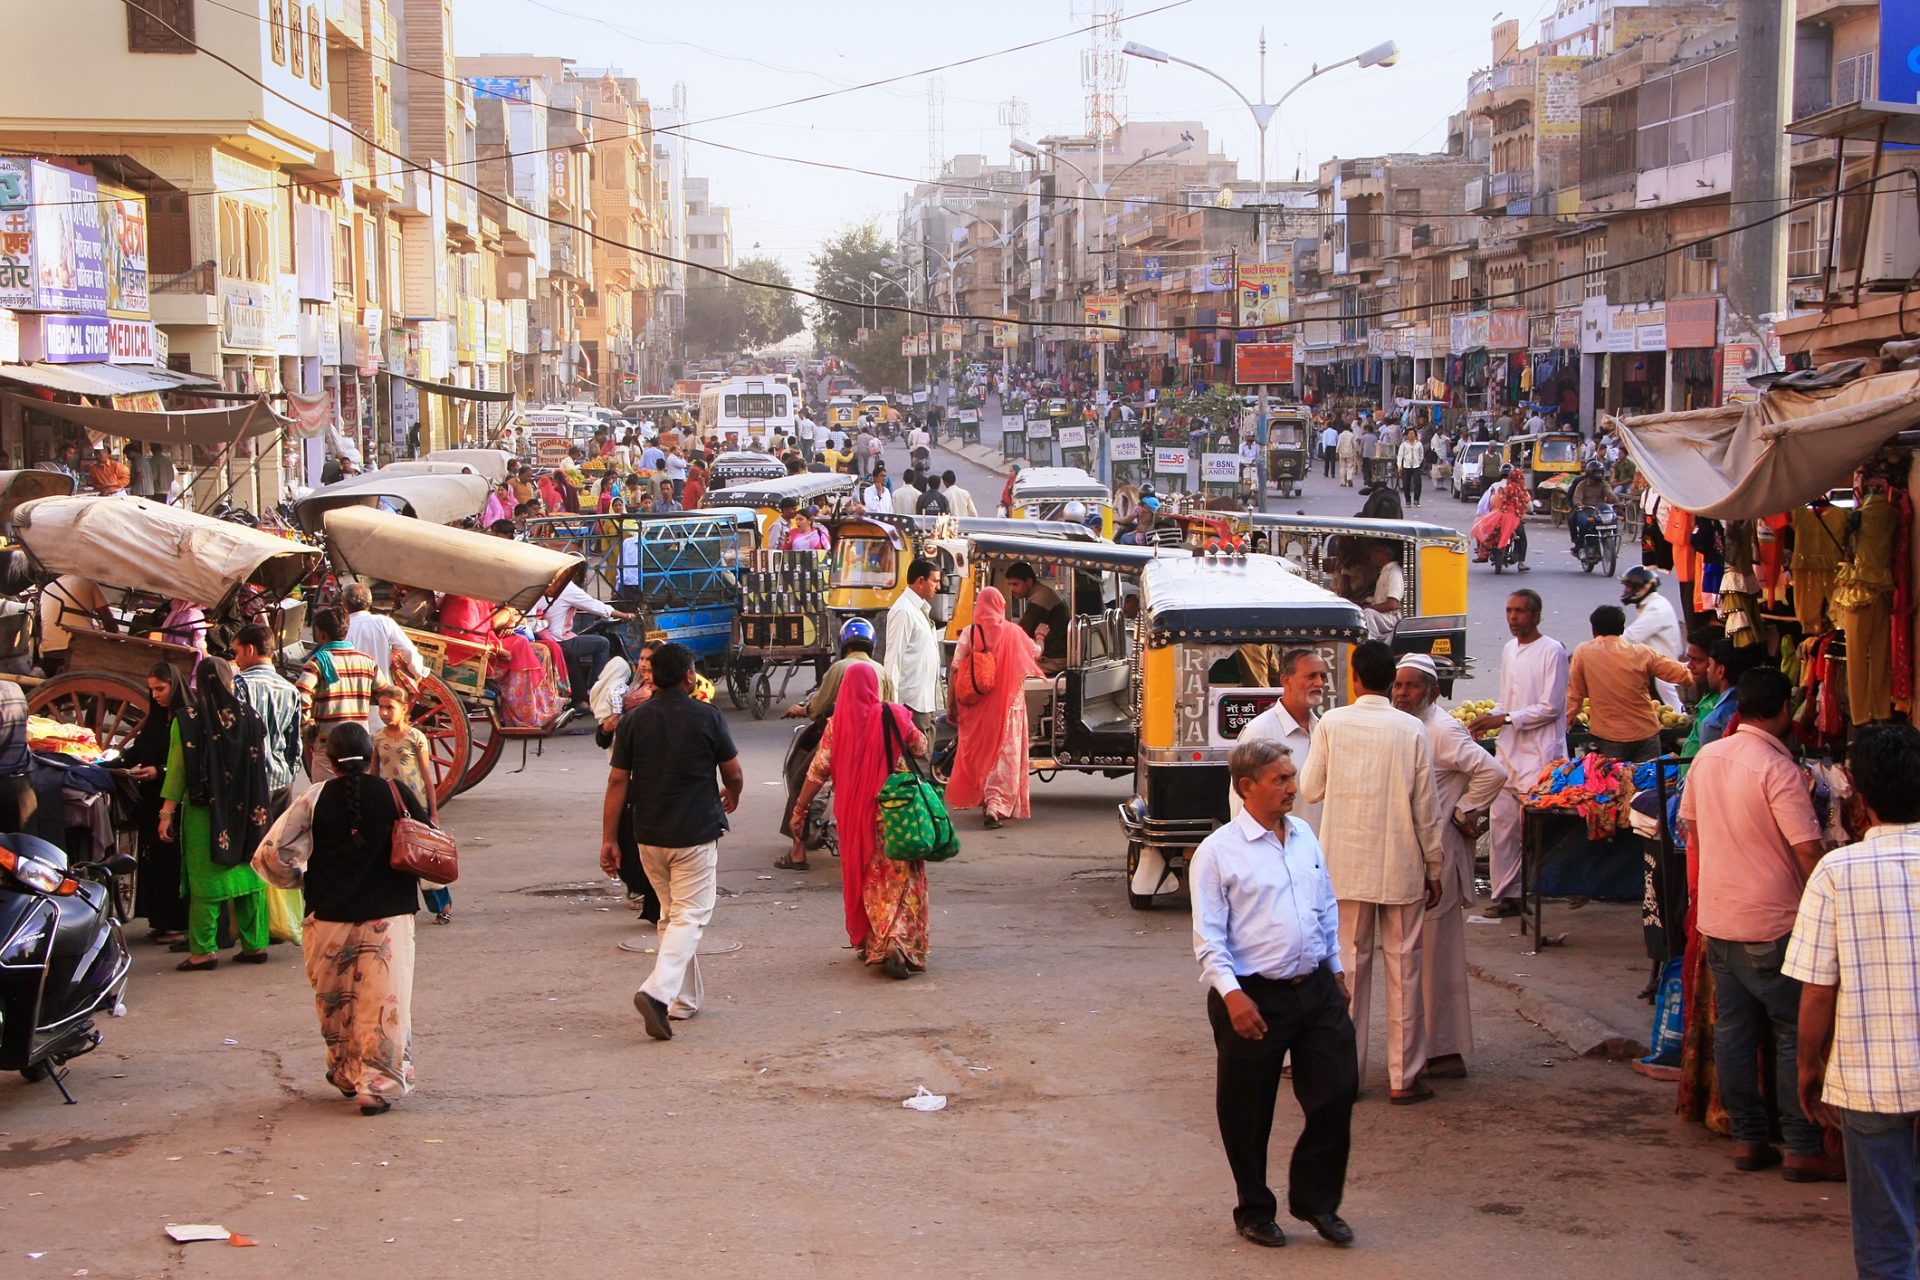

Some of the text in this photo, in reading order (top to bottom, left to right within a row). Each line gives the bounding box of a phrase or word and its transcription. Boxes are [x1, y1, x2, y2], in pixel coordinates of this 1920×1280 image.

[48, 324, 109, 354] MEDICAL STORE
[109, 323, 153, 357] MEDICAL
[1172, 454, 1185, 464] 3G
[1183, 649, 1206, 743] RAJA
[1317, 647, 1337, 716] RAJ
